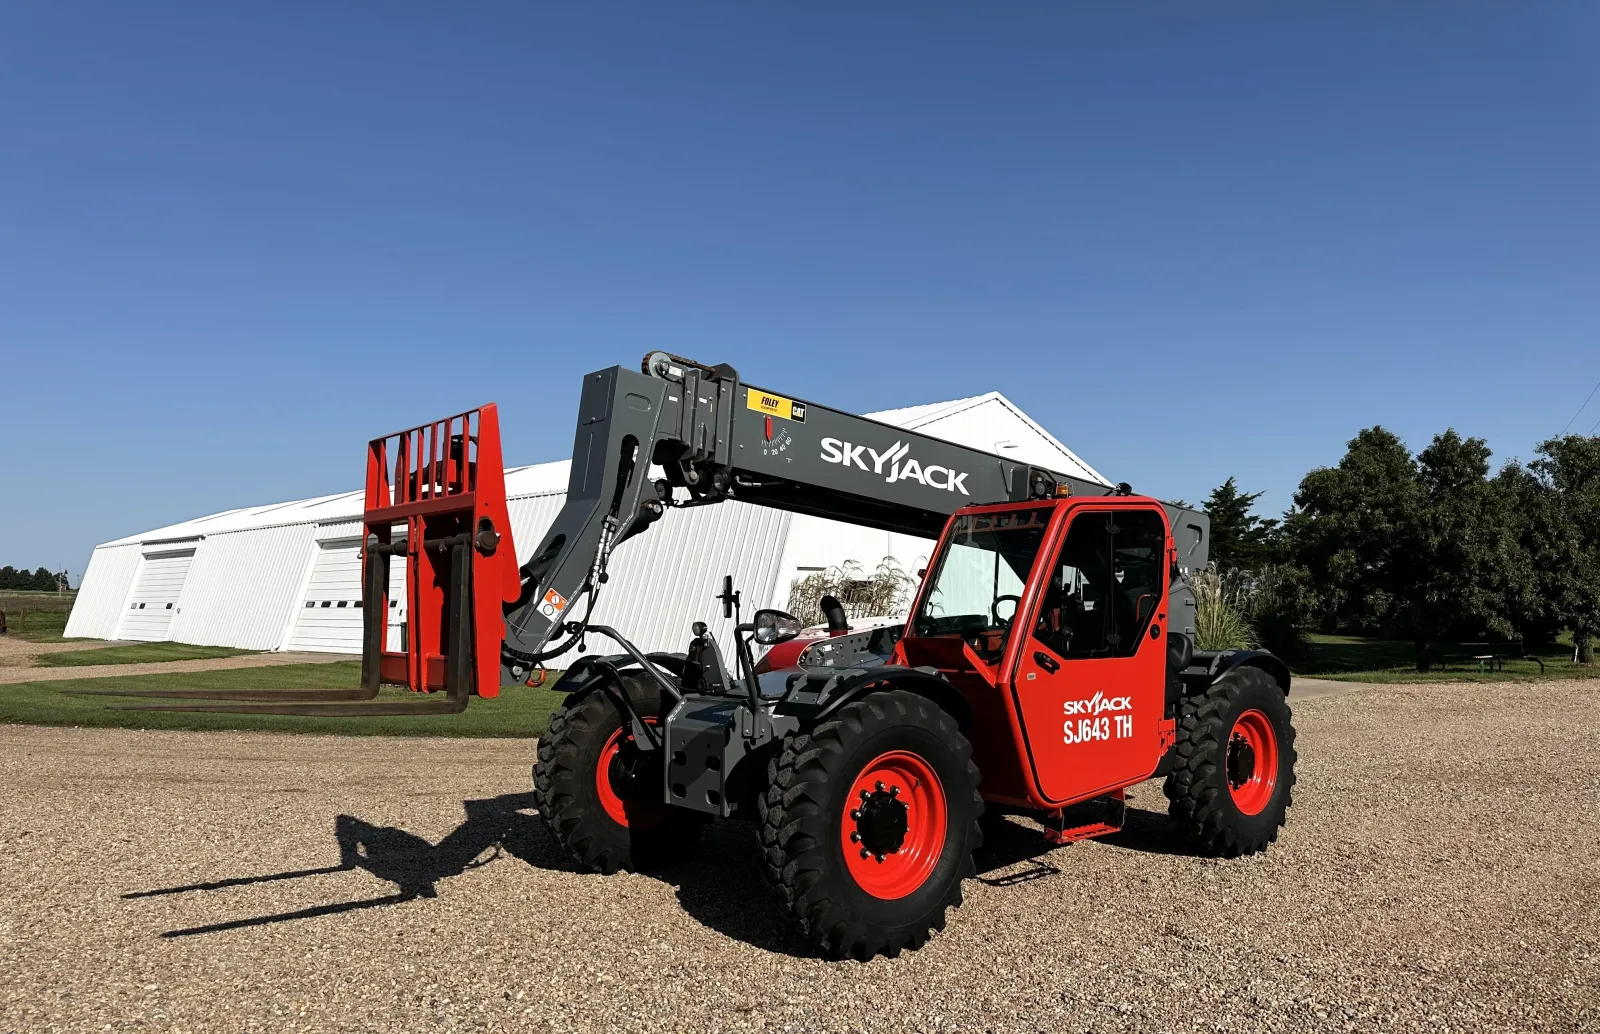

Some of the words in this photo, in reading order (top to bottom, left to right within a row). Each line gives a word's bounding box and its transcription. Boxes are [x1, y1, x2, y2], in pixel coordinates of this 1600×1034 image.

[761, 396, 779, 408] FOLEY
[792, 406, 805, 418] CAT
[771, 448, 779, 456] 20
[820, 437, 970, 496] SKYJACK
[1063, 690, 1133, 716] SKYJACK
[1063, 716, 1110, 745] SJ643
[1114, 714, 1133, 739] TH
